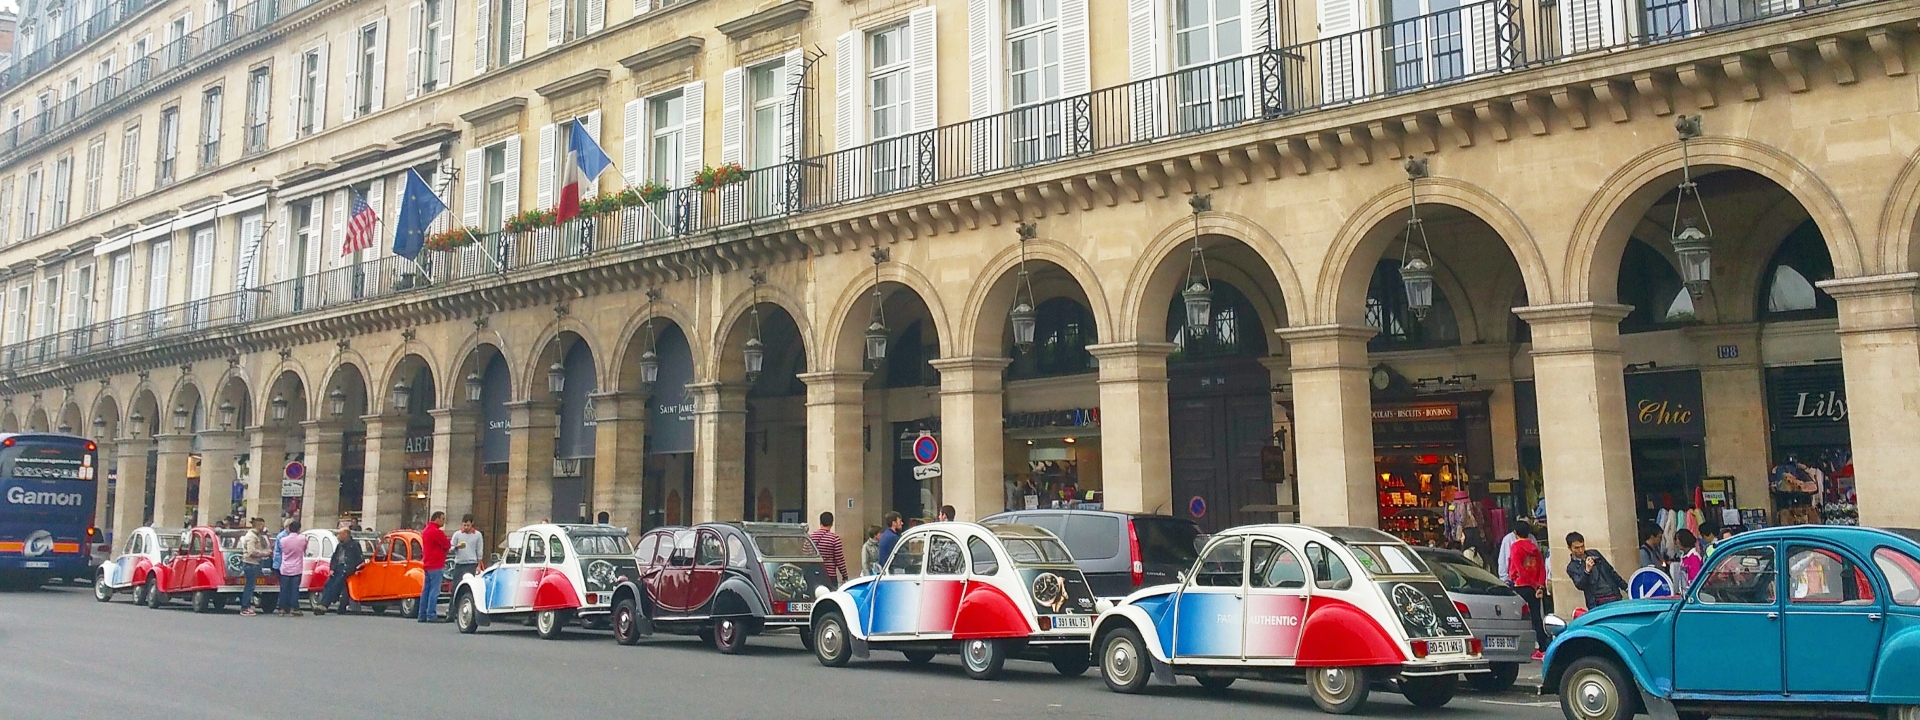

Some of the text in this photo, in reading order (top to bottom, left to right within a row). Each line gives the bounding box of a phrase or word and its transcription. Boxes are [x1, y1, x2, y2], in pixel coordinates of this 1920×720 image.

[1718, 345, 1738, 358] 198
[659, 404, 678, 415] SAINT
[1397, 409, 1422, 418] BISCUITS
[1425, 407, 1452, 417] BONBONS
[1637, 398, 1693, 426] Chic
[1793, 391, 1849, 422] Lily
[405, 436, 434, 453] ART
[7, 486, 82, 506] Gamon
[1079, 617, 1087, 627] 75
[1247, 615, 1298, 626] AUTHENTIC
